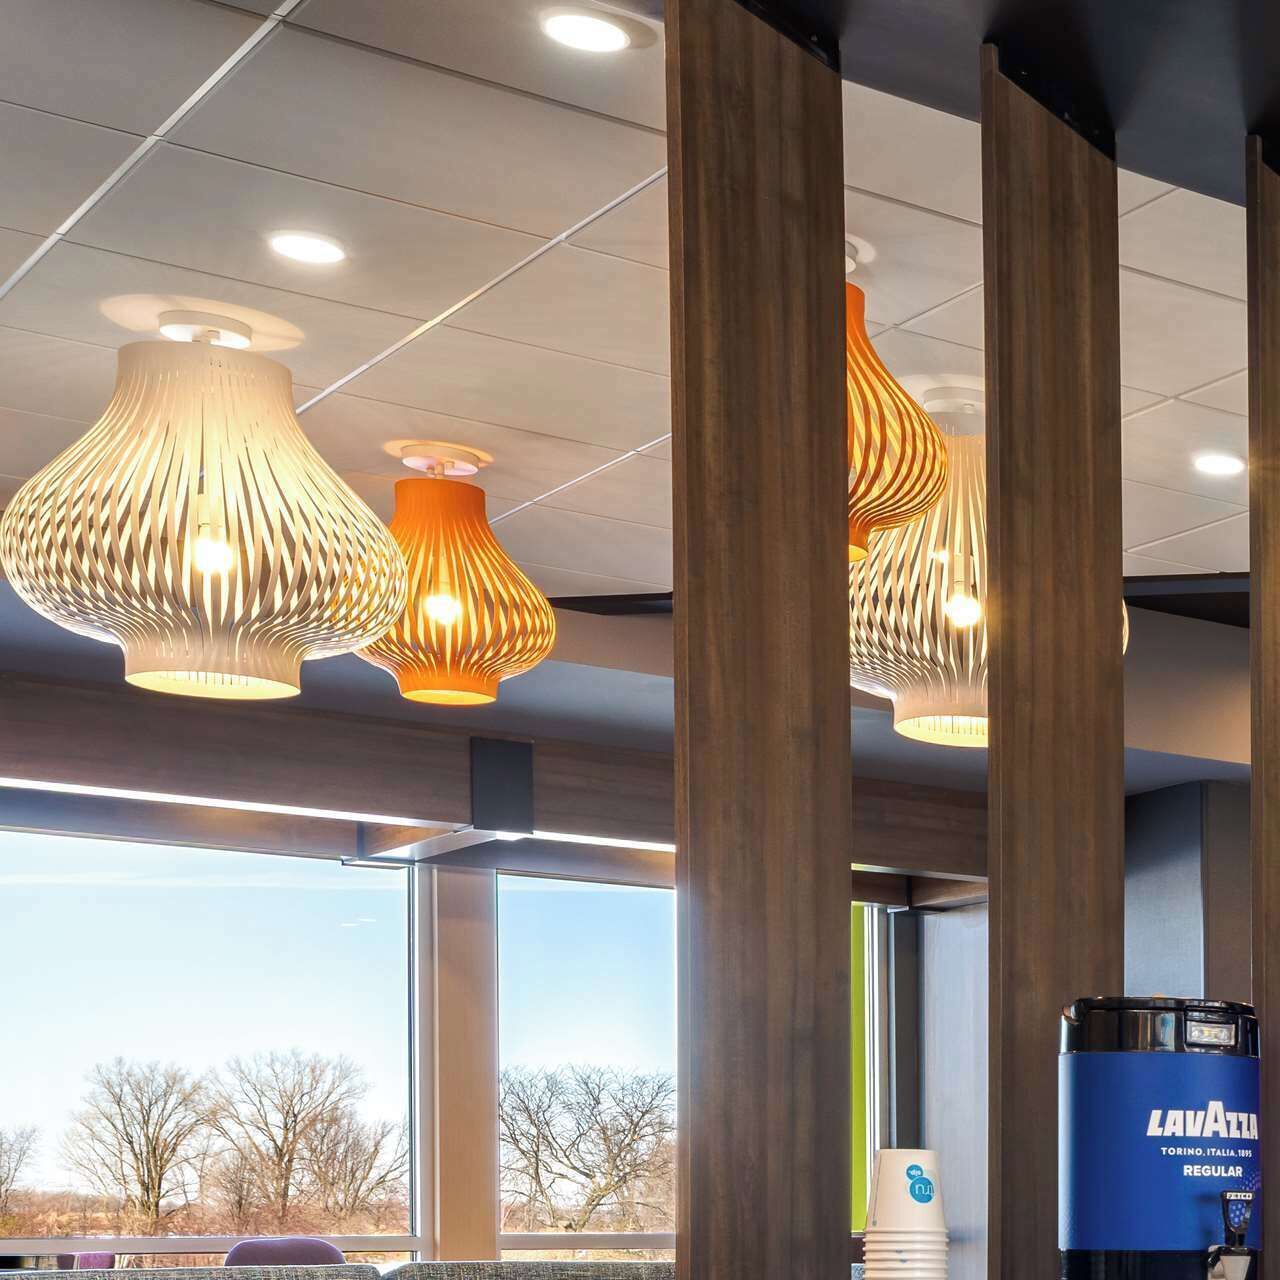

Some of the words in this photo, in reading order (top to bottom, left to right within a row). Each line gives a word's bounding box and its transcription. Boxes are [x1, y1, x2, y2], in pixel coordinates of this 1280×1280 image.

[1146, 1100, 1259, 1140] LAVAZZA
[1238, 1149, 1253, 1158] 1895
[1183, 1164, 1243, 1177] REGULAR
